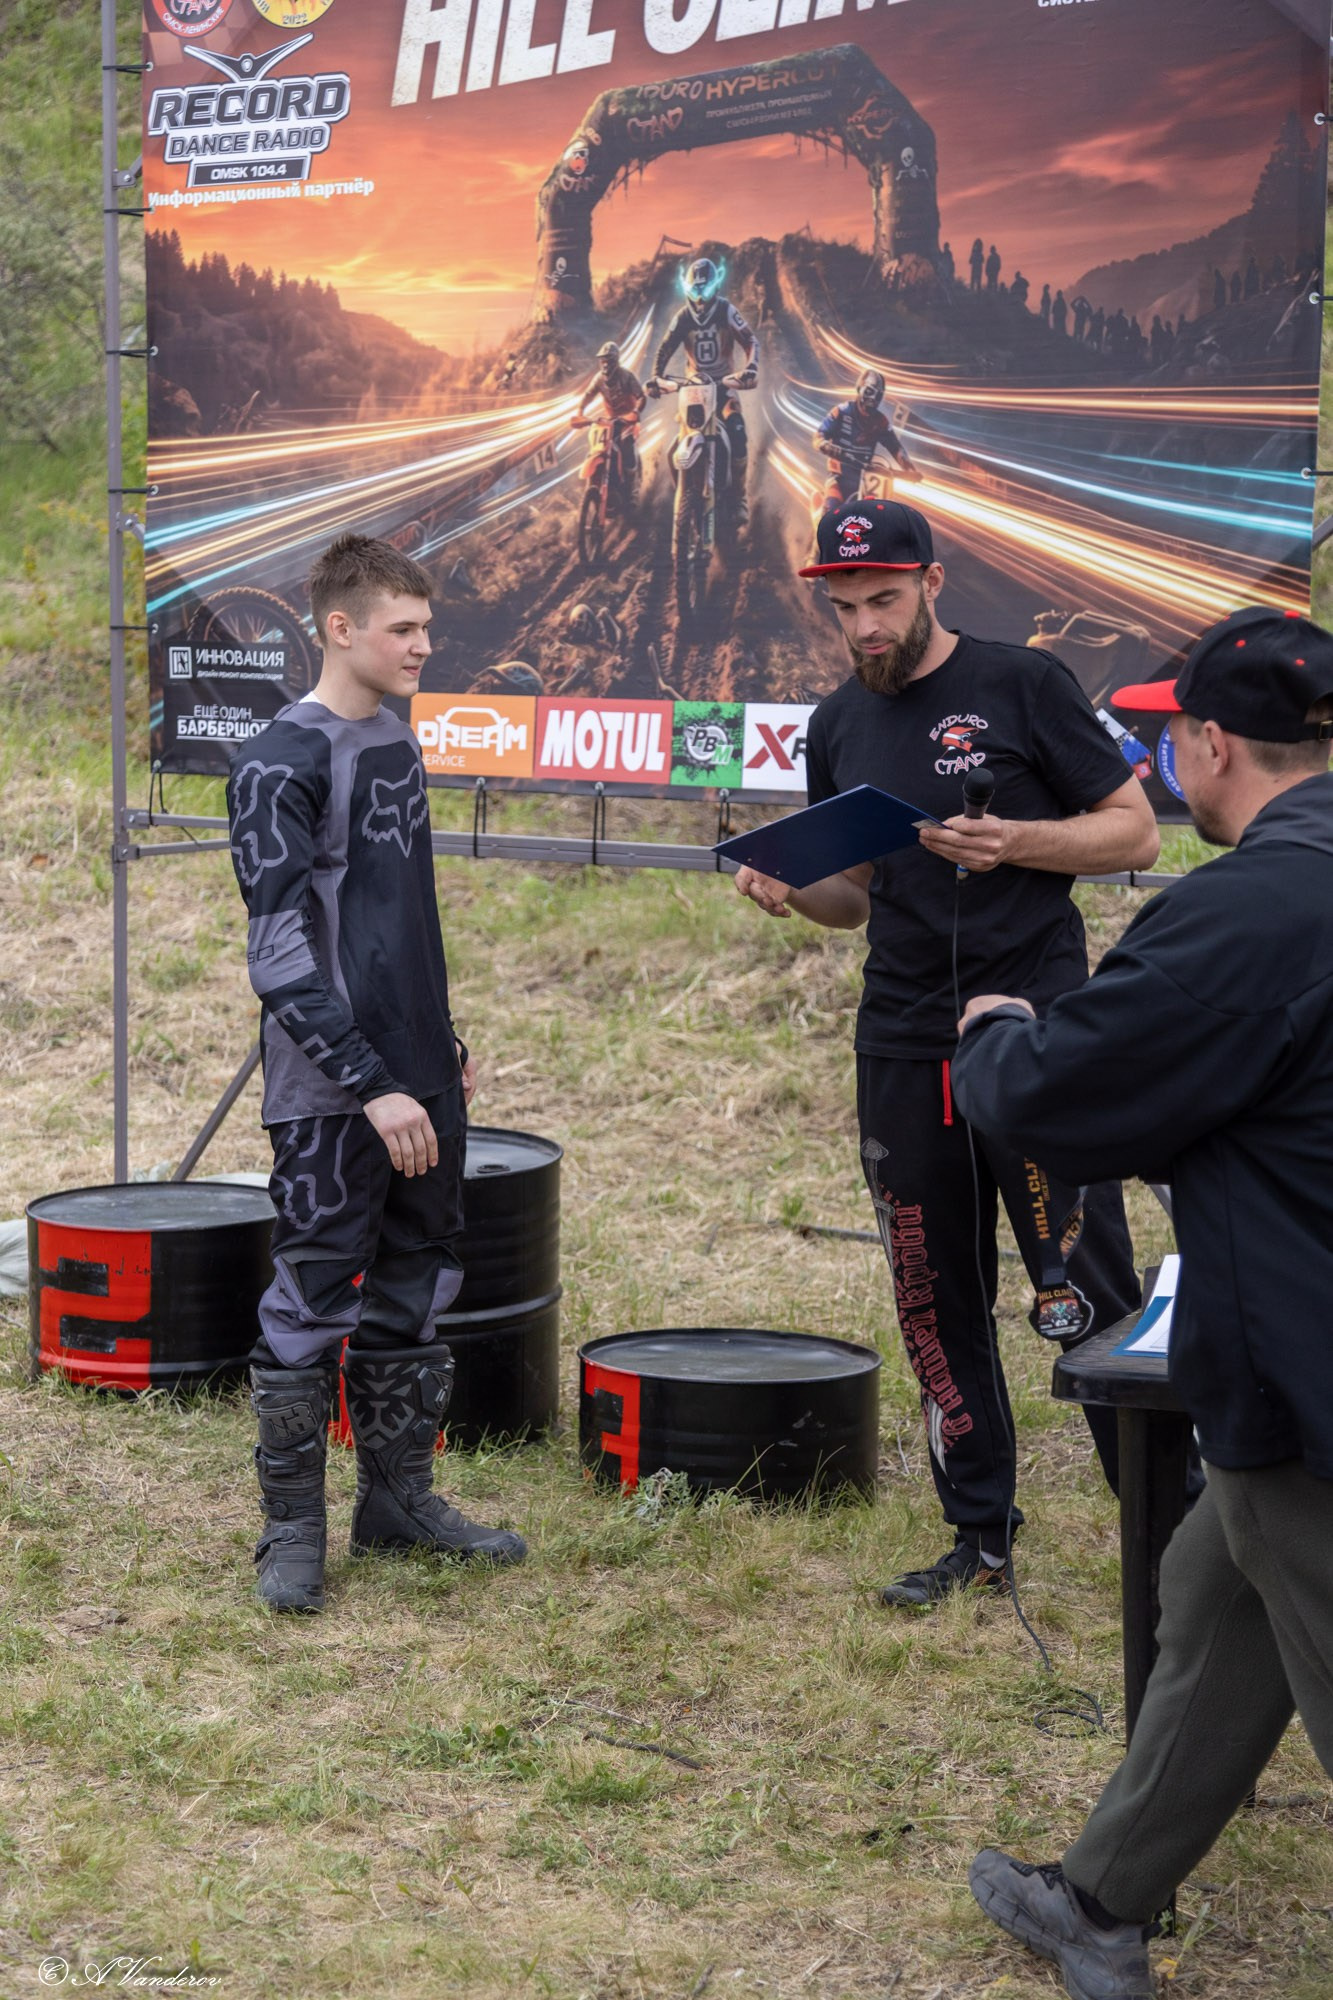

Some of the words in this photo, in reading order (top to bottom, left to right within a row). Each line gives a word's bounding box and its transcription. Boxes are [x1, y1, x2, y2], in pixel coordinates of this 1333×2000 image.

[282, 13, 308, 25] 2022
[390, 0, 616, 107] HILL
[149, 78, 349, 132] RECORD
[169, 131, 250, 158] DANCE
[253, 125, 326, 150] RADIO
[210, 166, 248, 180] OMSK
[250, 163, 287, 178] 104.4
[148, 182, 301, 209] Информационный
[304, 178, 375, 199] партнёр
[195, 648, 285, 668] ИННОВАЦИЯ
[219, 706, 253, 720] ОДИН
[929, 714, 989, 741] ENDURO
[417, 713, 528, 757] DREAM
[540, 709, 666, 772] MOTUL
[422, 753, 467, 768] ERVICE
[1032, 1196, 1051, 1240] HILL
